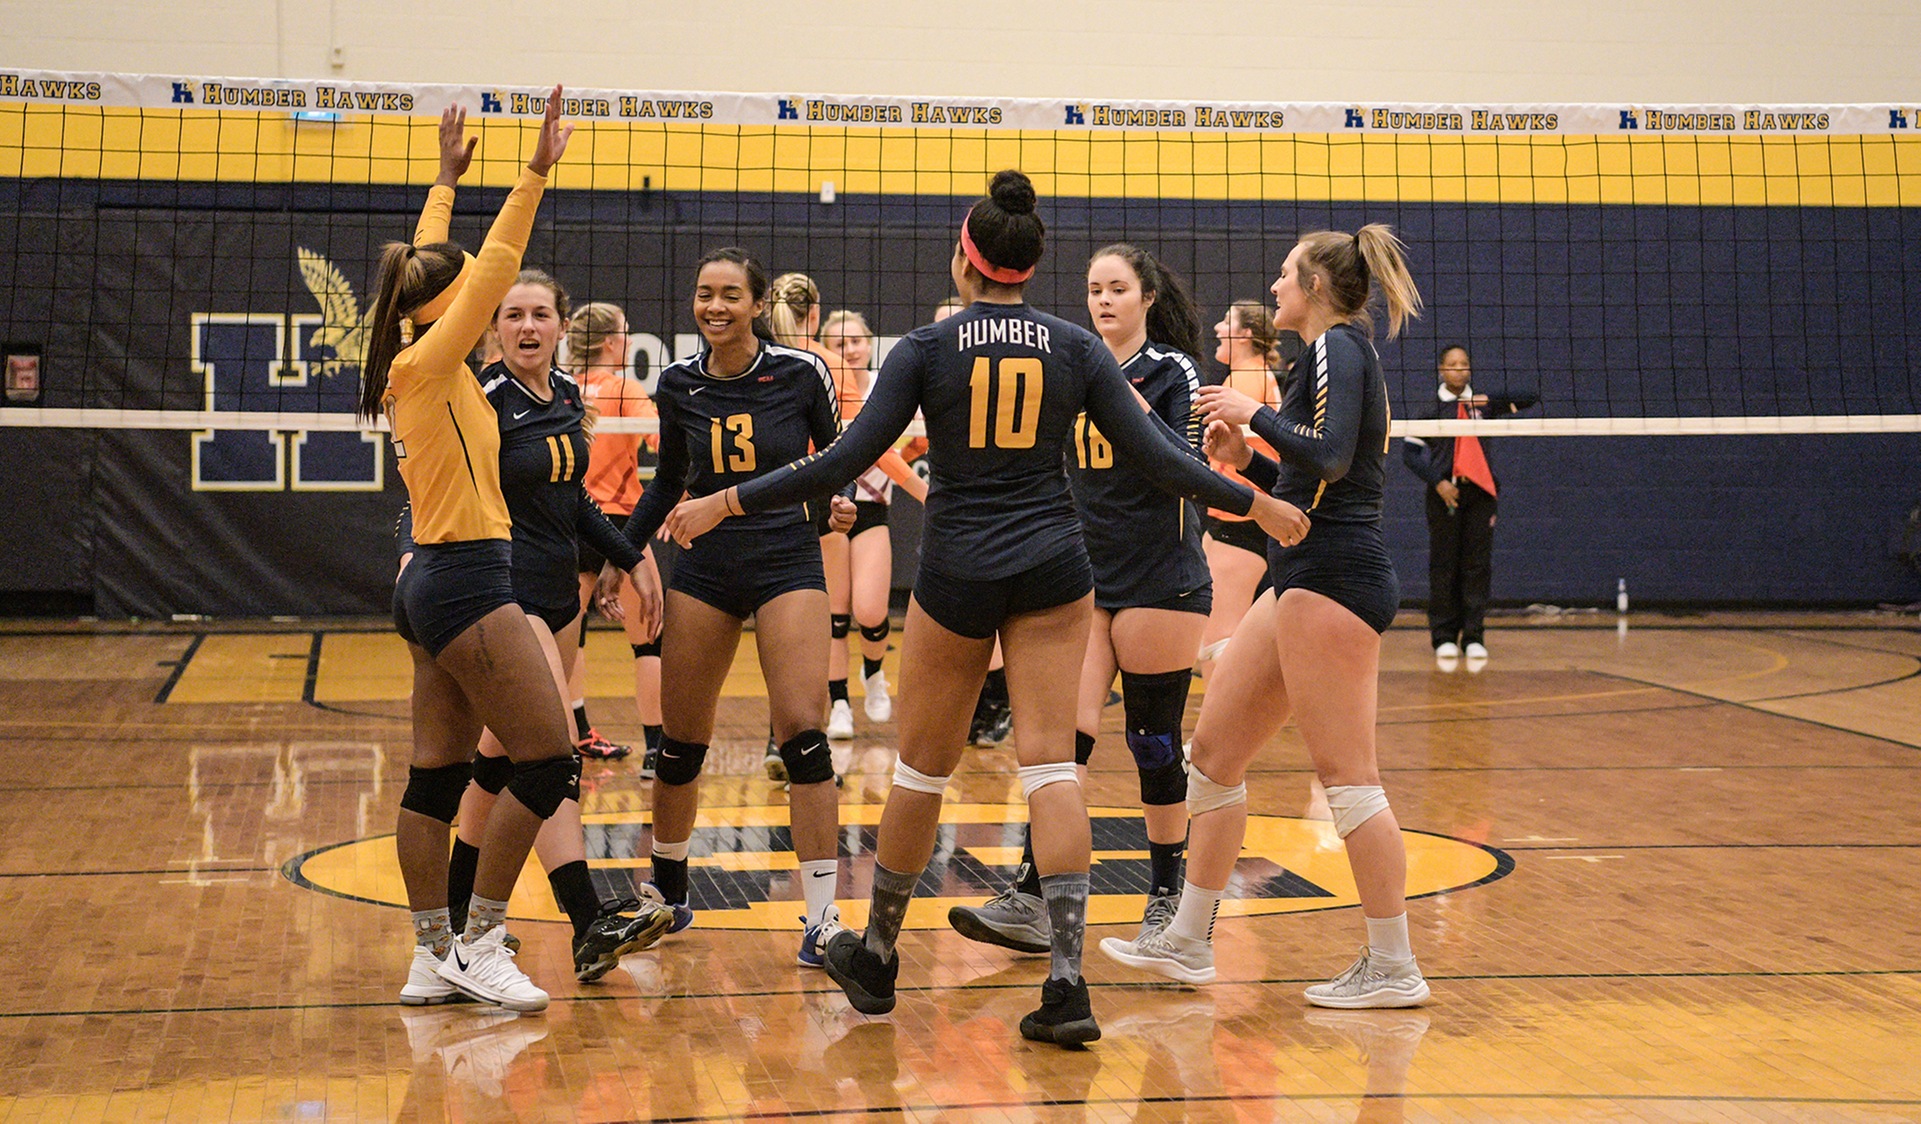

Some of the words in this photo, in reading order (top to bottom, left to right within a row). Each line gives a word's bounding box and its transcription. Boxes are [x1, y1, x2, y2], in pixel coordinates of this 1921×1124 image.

[0, 75, 101, 100] HAWKS
[202, 83, 307, 108] HUMBER
[316, 87, 414, 111] HAWKS
[511, 93, 610, 116] HUBER
[619, 96, 714, 118] HAWKS
[806, 100, 902, 122] HUMBER
[911, 102, 1002, 124] HAWKS
[1093, 105, 1186, 126] HUMBER
[1195, 107, 1284, 128] HAWKS
[1371, 108, 1463, 130] HUMBER
[1471, 110, 1559, 131] HAWKS
[1645, 110, 1736, 130] HUMBER
[1743, 110, 1830, 130] HAWKS
[958, 318, 1052, 354] HUMBER
[969, 356, 1043, 449] 10
[710, 413, 756, 474] 13
[547, 433, 575, 483] 11
